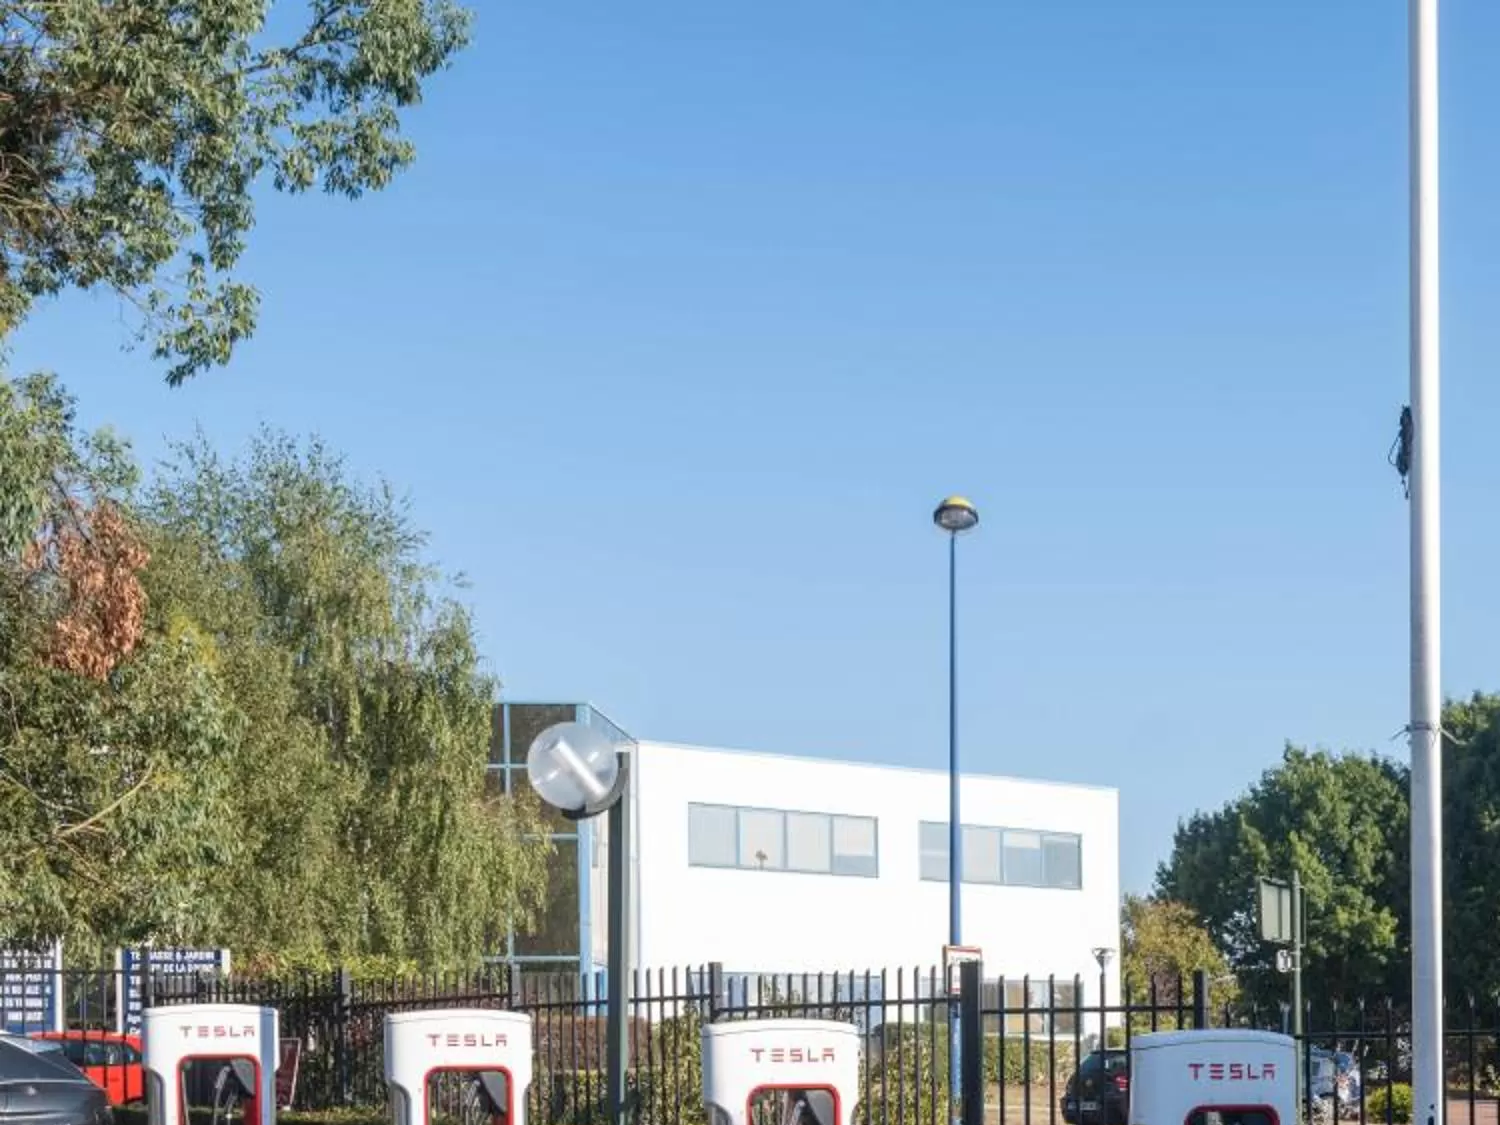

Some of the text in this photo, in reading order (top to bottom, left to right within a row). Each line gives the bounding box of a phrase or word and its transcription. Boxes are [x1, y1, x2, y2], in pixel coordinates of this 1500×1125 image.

[179, 1025, 255, 1037] TESLA
[427, 1033, 507, 1047] TESLA
[750, 1047, 835, 1063] TESLA
[1187, 1063, 1276, 1081] TESLA
